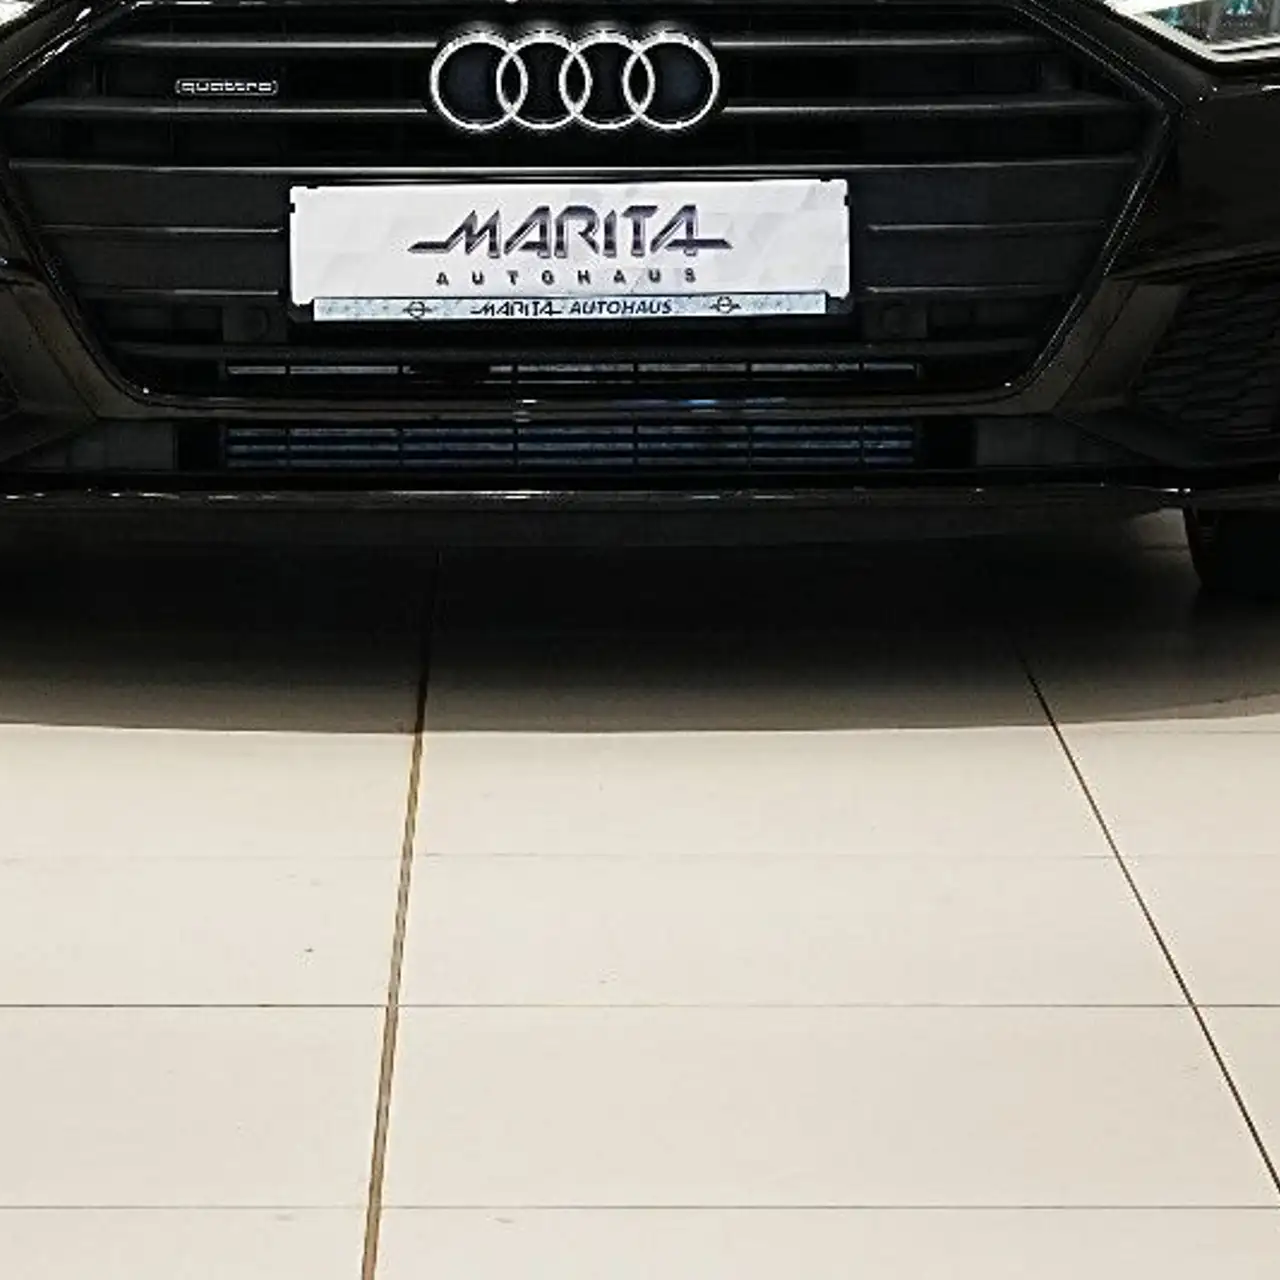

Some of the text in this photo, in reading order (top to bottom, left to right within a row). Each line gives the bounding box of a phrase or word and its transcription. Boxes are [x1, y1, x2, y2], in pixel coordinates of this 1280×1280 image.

[181, 81, 273, 94] quattro
[407, 204, 733, 259] MARITA
[436, 267, 697, 287] AUTOHAUS
[470, 299, 673, 317] MARITA AUTOHAUS
